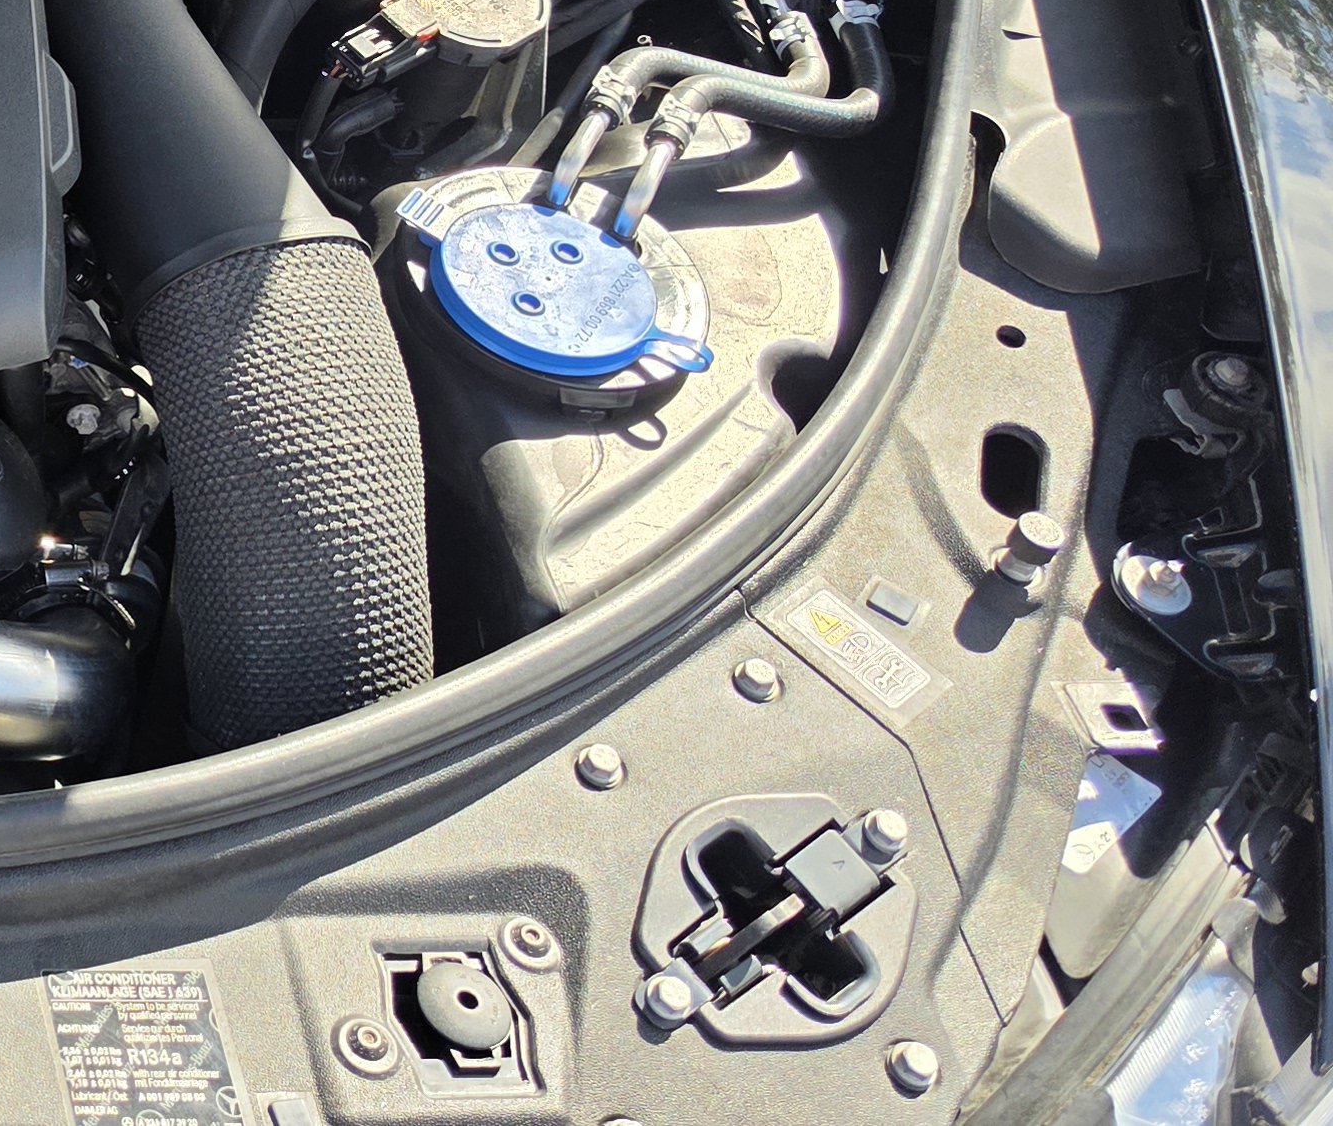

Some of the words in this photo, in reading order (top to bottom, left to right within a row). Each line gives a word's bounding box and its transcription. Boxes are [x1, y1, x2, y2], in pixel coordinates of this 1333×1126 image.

[610, 279, 629, 297] 221
[596, 296, 616, 316] 869
[585, 314, 603, 329] 00
[74, 973, 93, 985] AIR
[95, 972, 176, 985] CONDITIONER
[52, 986, 137, 998] KLIMAANLAGE
[138, 986, 166, 999] (SAE
[176, 986, 203, 999] 639)
[116, 1002, 145, 1012] System
[146, 1002, 155, 1011] to
[156, 1002, 166, 1011] be
[167, 1002, 199, 1011] serviced
[118, 1011, 128, 1021] by
[129, 1011, 161, 1021] qualified
[165, 1024, 186, 1033] durch
[127, 1048, 183, 1065] R134a
